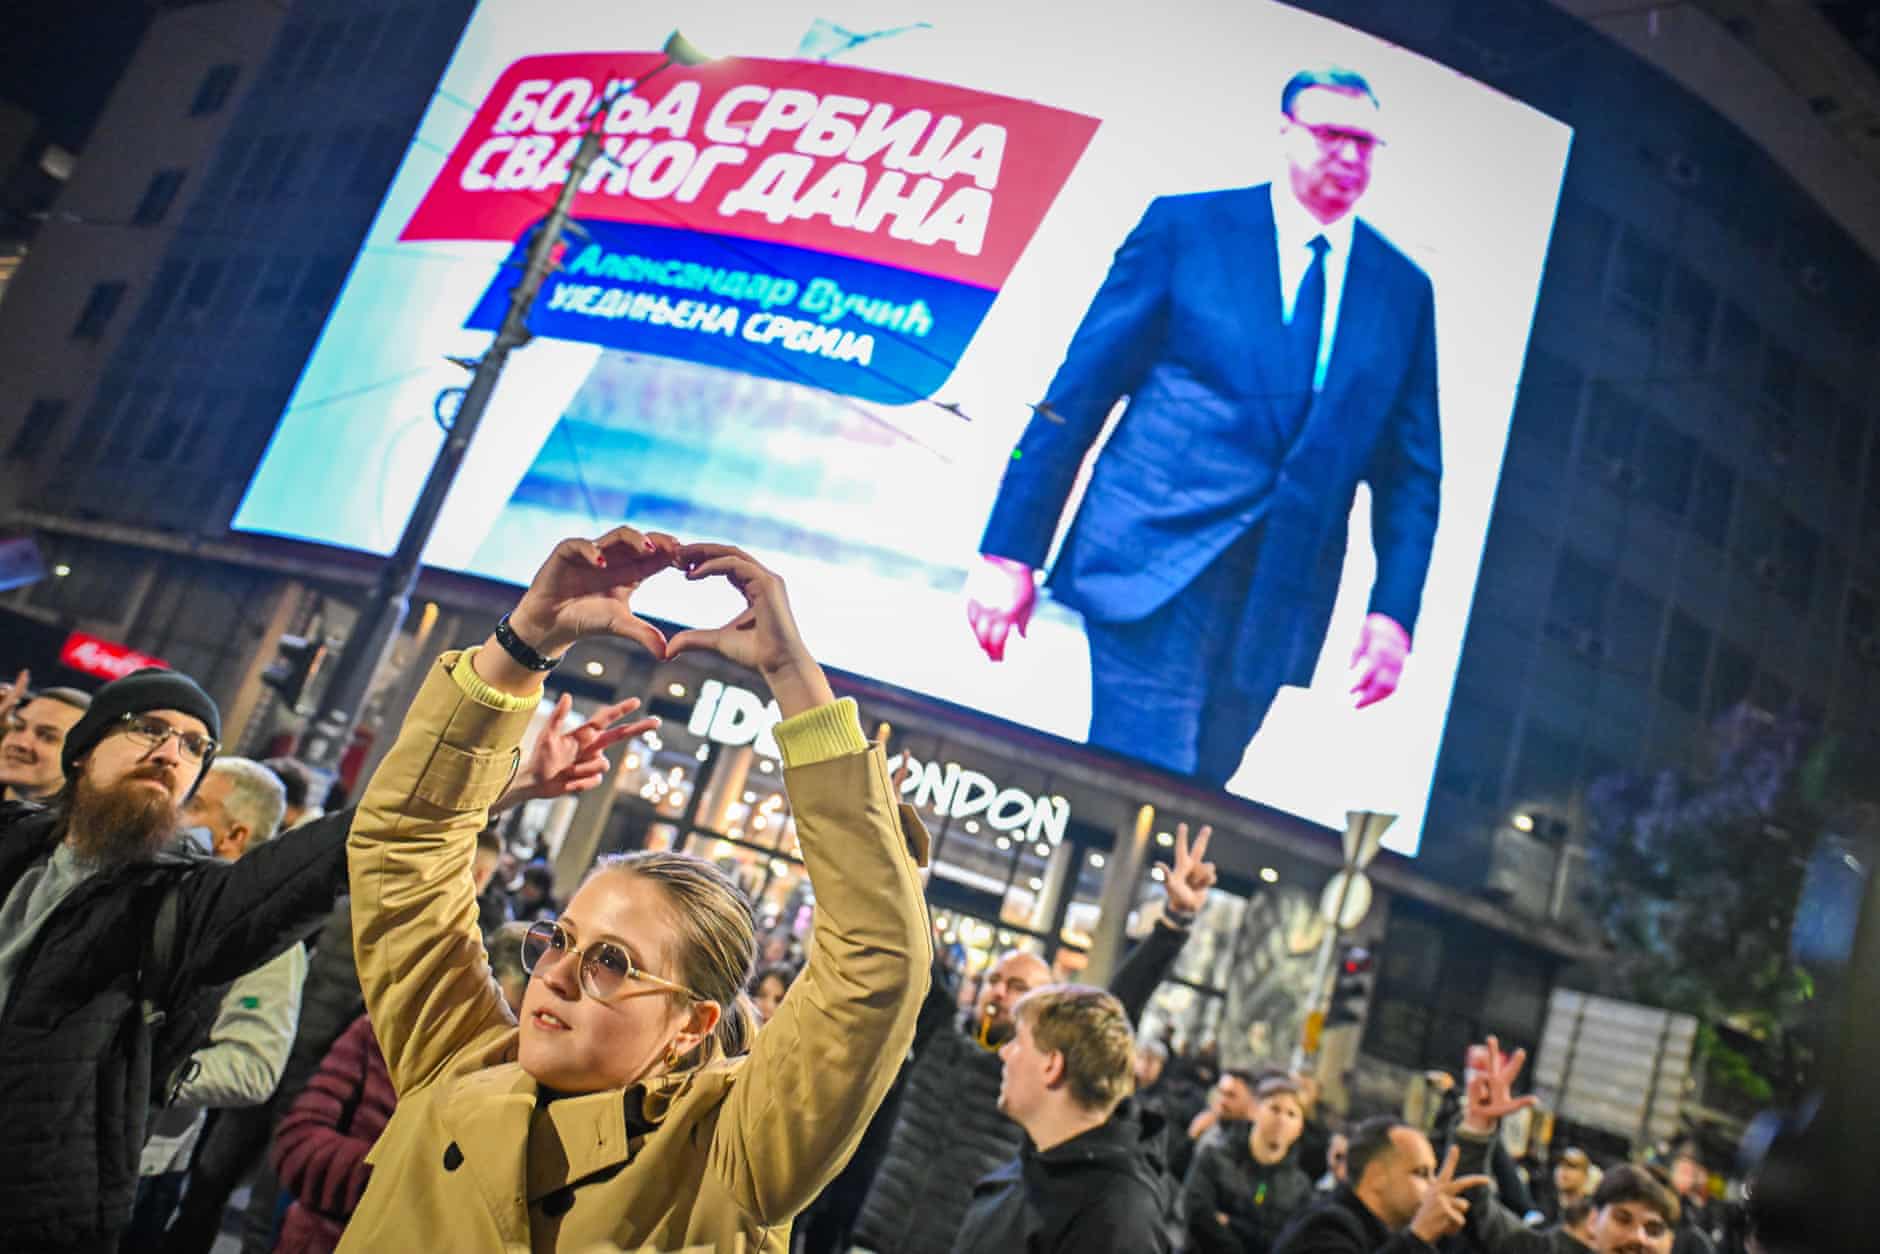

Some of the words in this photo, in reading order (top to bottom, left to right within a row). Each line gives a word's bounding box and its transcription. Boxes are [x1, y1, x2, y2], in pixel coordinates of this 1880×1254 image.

[703, 84, 1008, 190] СРБИЈА
[716, 152, 993, 256] ДАНА
[567, 243, 799, 309] Александар
[798, 276, 935, 338] Вучић
[741, 311, 876, 367] СРБИЈА
[887, 753, 1072, 847] ONDON
